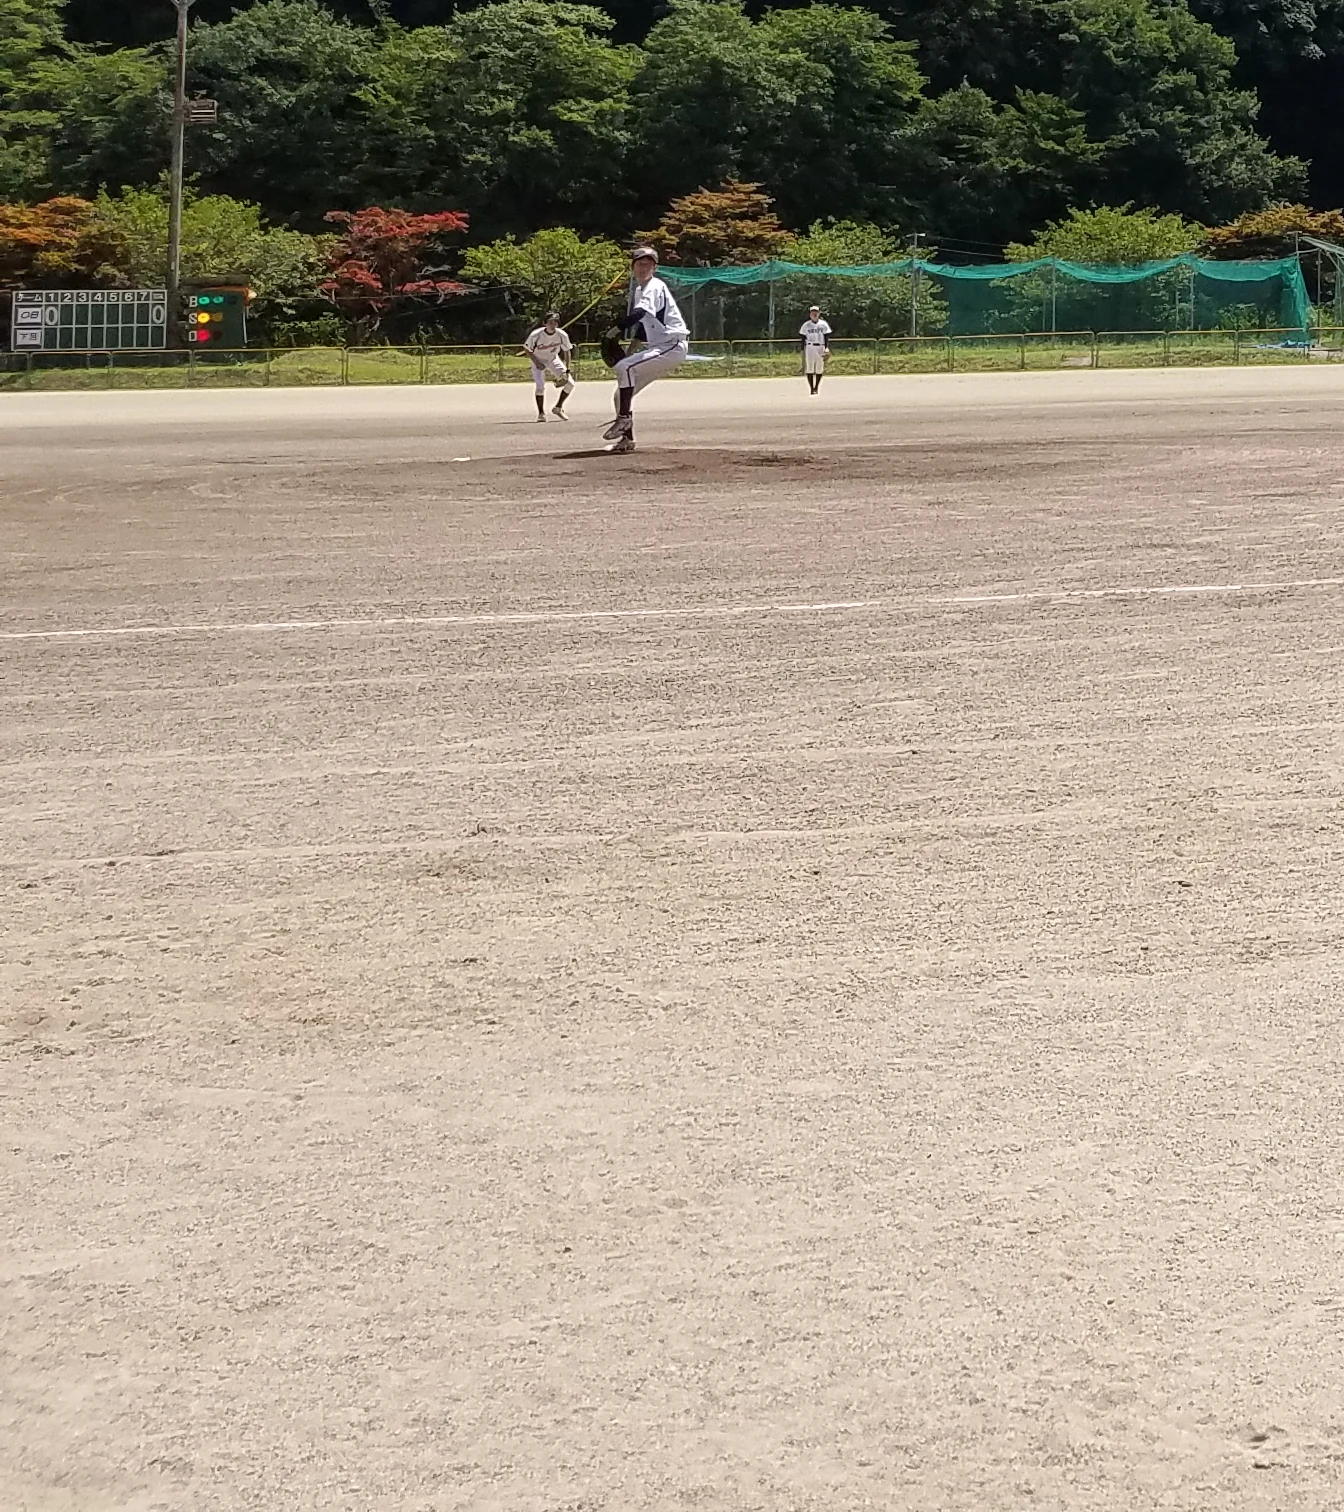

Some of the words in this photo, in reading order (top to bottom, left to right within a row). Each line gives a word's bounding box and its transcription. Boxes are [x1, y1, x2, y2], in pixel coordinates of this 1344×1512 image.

[48, 292, 55, 302] 1
[63, 292, 72, 302] 2
[78, 292, 87, 302] 3
[93, 292, 103, 301] 4
[109, 292, 118, 301] 5
[124, 292, 133, 301] 6
[139, 291, 148, 301] 7
[189, 295, 198, 307] B
[45, 306, 58, 326] 0
[152, 304, 165, 324] 0
[189, 312, 198, 324] S
